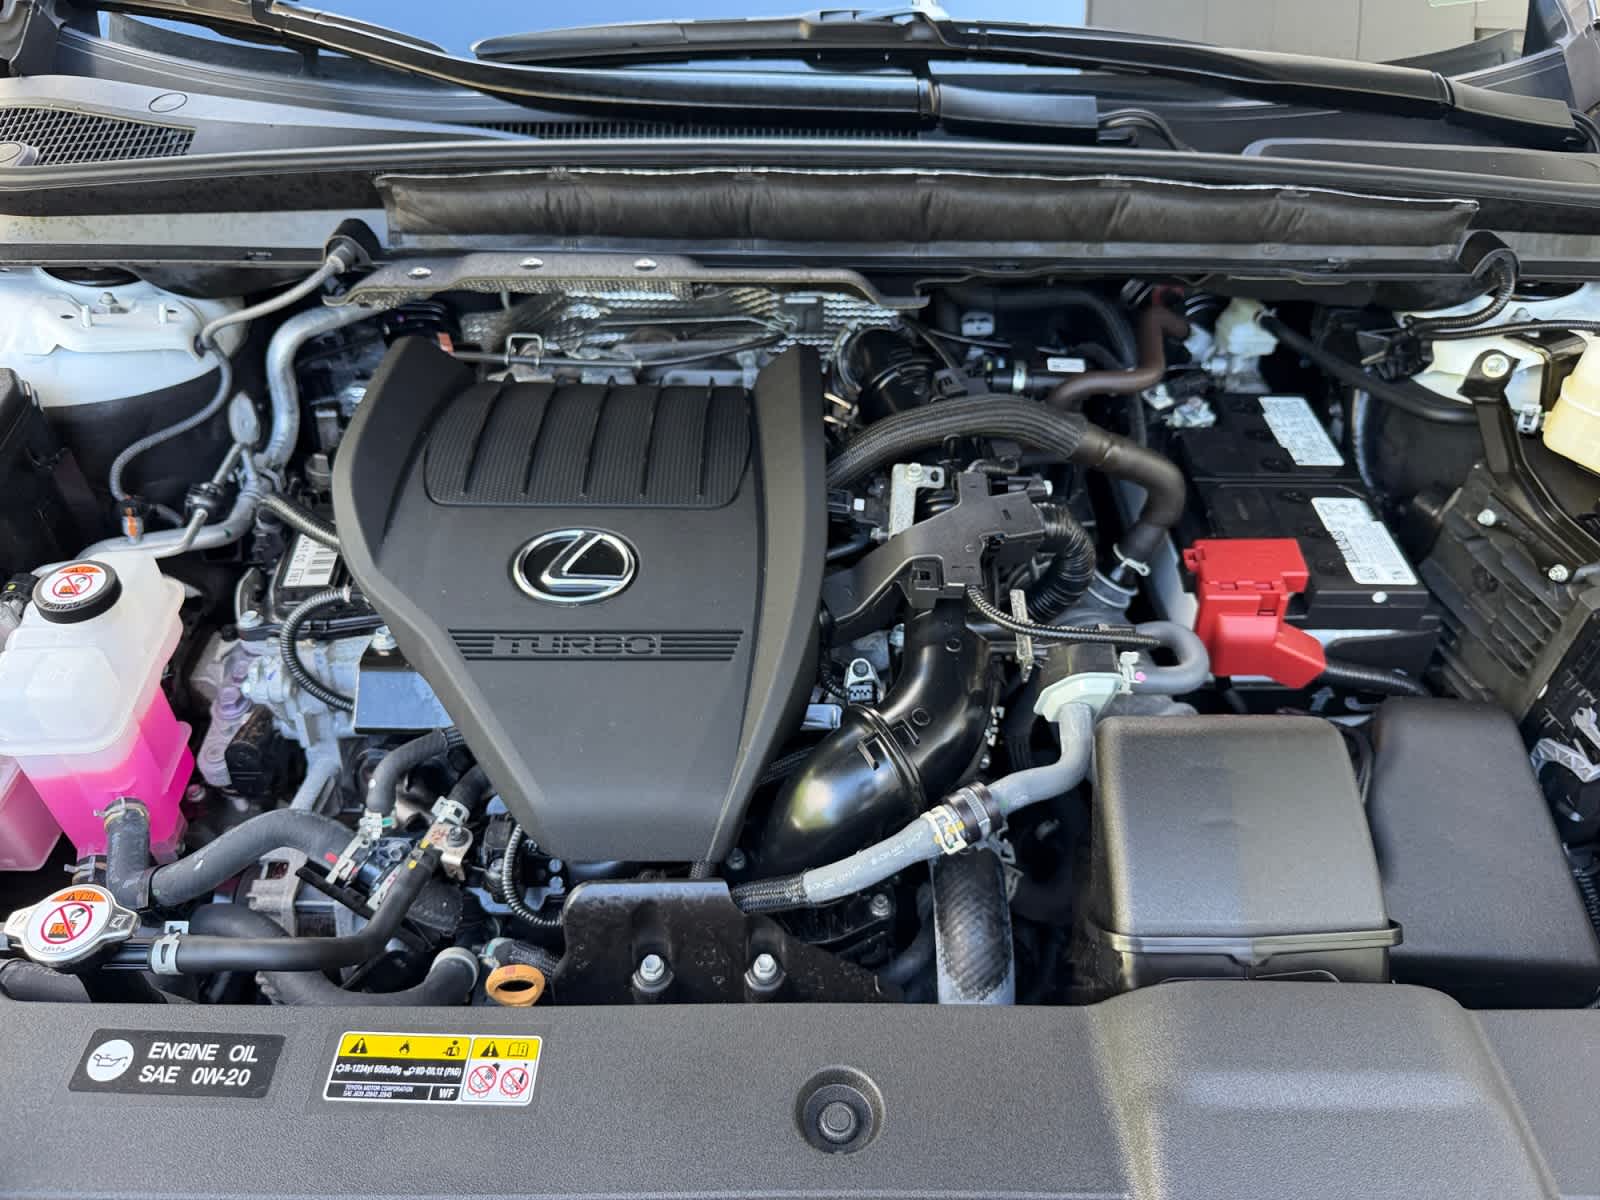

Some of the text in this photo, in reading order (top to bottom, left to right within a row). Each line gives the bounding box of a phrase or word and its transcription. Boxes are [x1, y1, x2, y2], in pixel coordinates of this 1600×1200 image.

[499, 633, 657, 655] TURBO
[147, 1041, 259, 1063] ENGINE OIL
[138, 1064, 252, 1087] SAE 0W-20
[438, 1087, 455, 1099] WF
